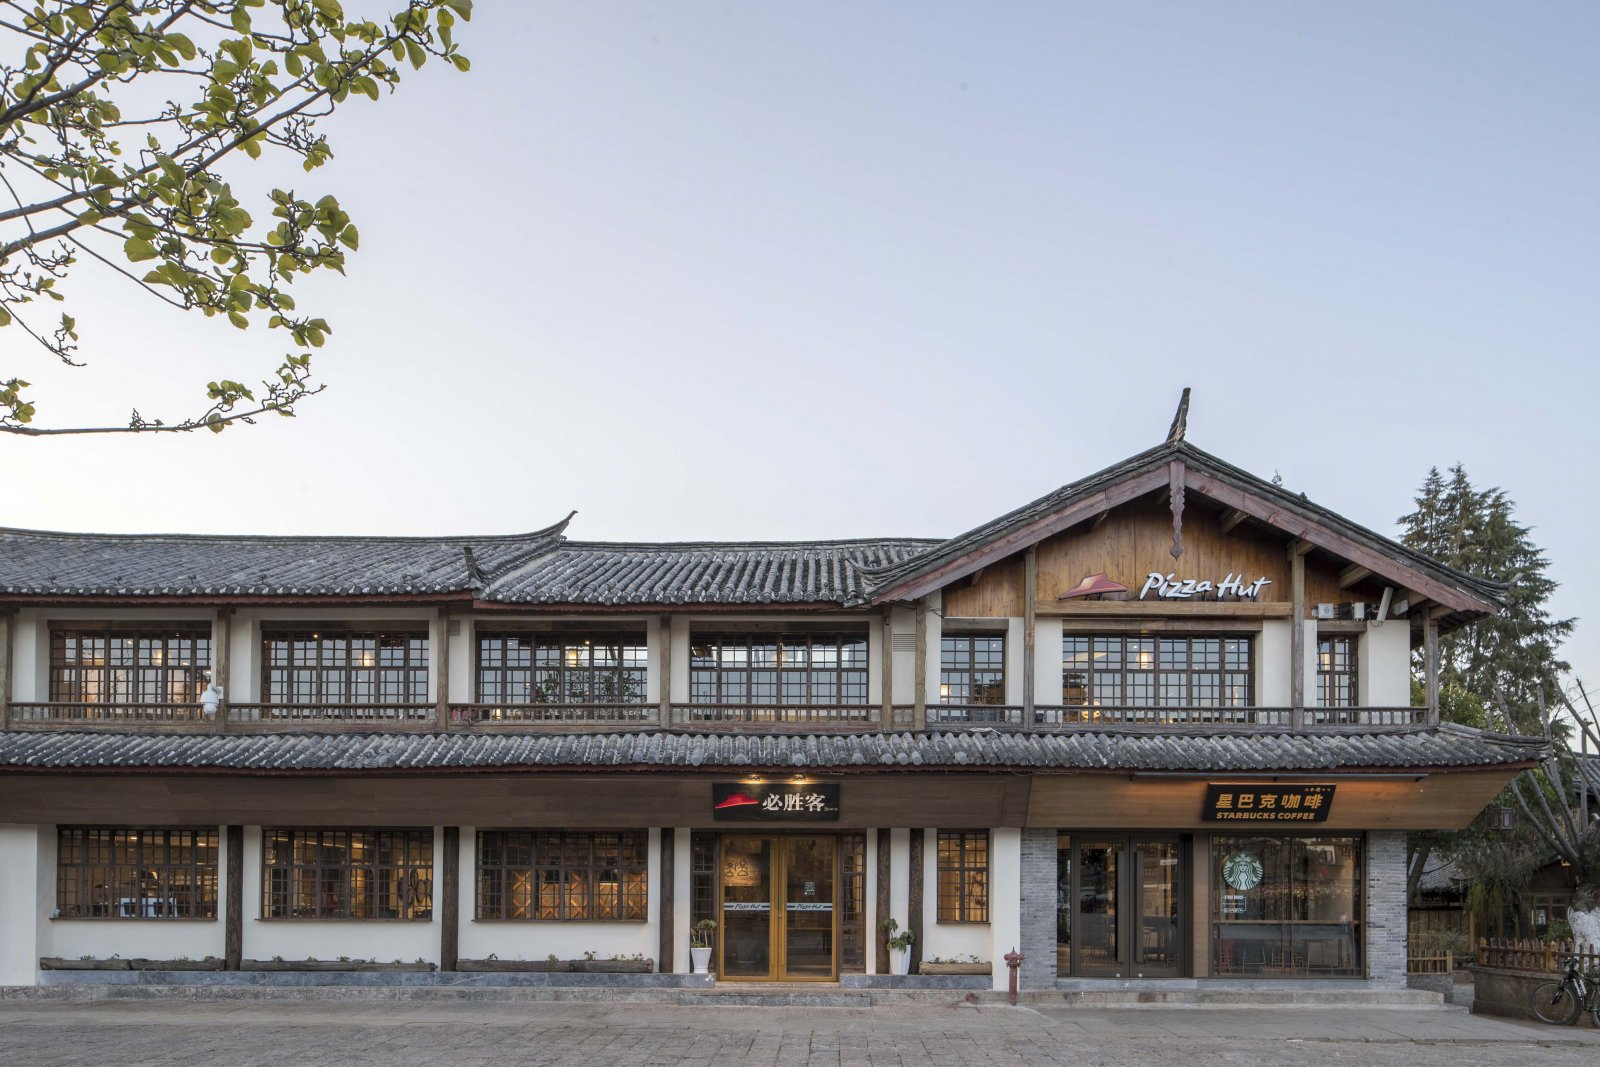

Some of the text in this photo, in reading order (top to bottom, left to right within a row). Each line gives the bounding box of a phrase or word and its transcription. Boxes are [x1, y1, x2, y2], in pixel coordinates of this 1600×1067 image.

[1139, 572, 1272, 600] Pizza Hut
[762, 793, 826, 812] 必胜客
[1215, 794, 1323, 809] 星巴克咖啡
